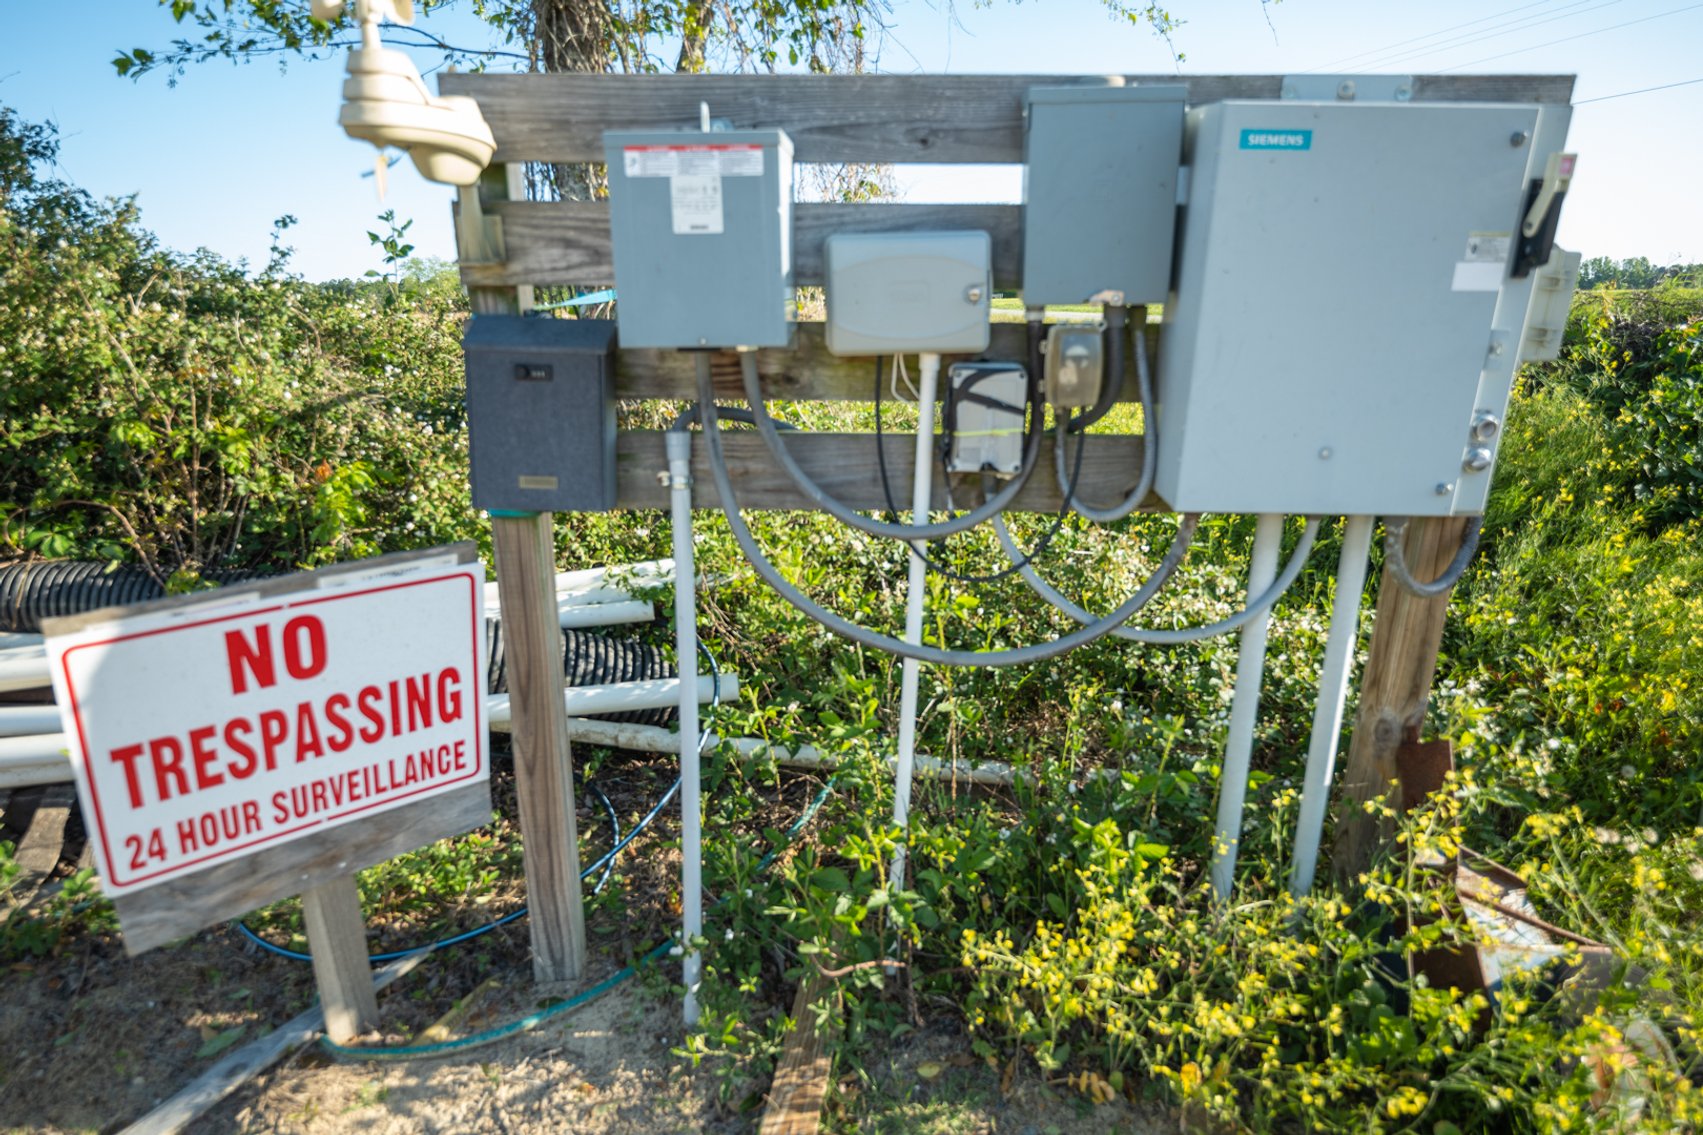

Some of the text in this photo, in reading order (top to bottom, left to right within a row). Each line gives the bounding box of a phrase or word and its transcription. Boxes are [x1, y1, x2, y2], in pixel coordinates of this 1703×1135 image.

[1247, 133, 1304, 146] SIEMENS
[224, 614, 328, 695] NO
[109, 666, 463, 809] TRESPASSING
[125, 739, 466, 871] 24 HOUR SURVEILLANCE
